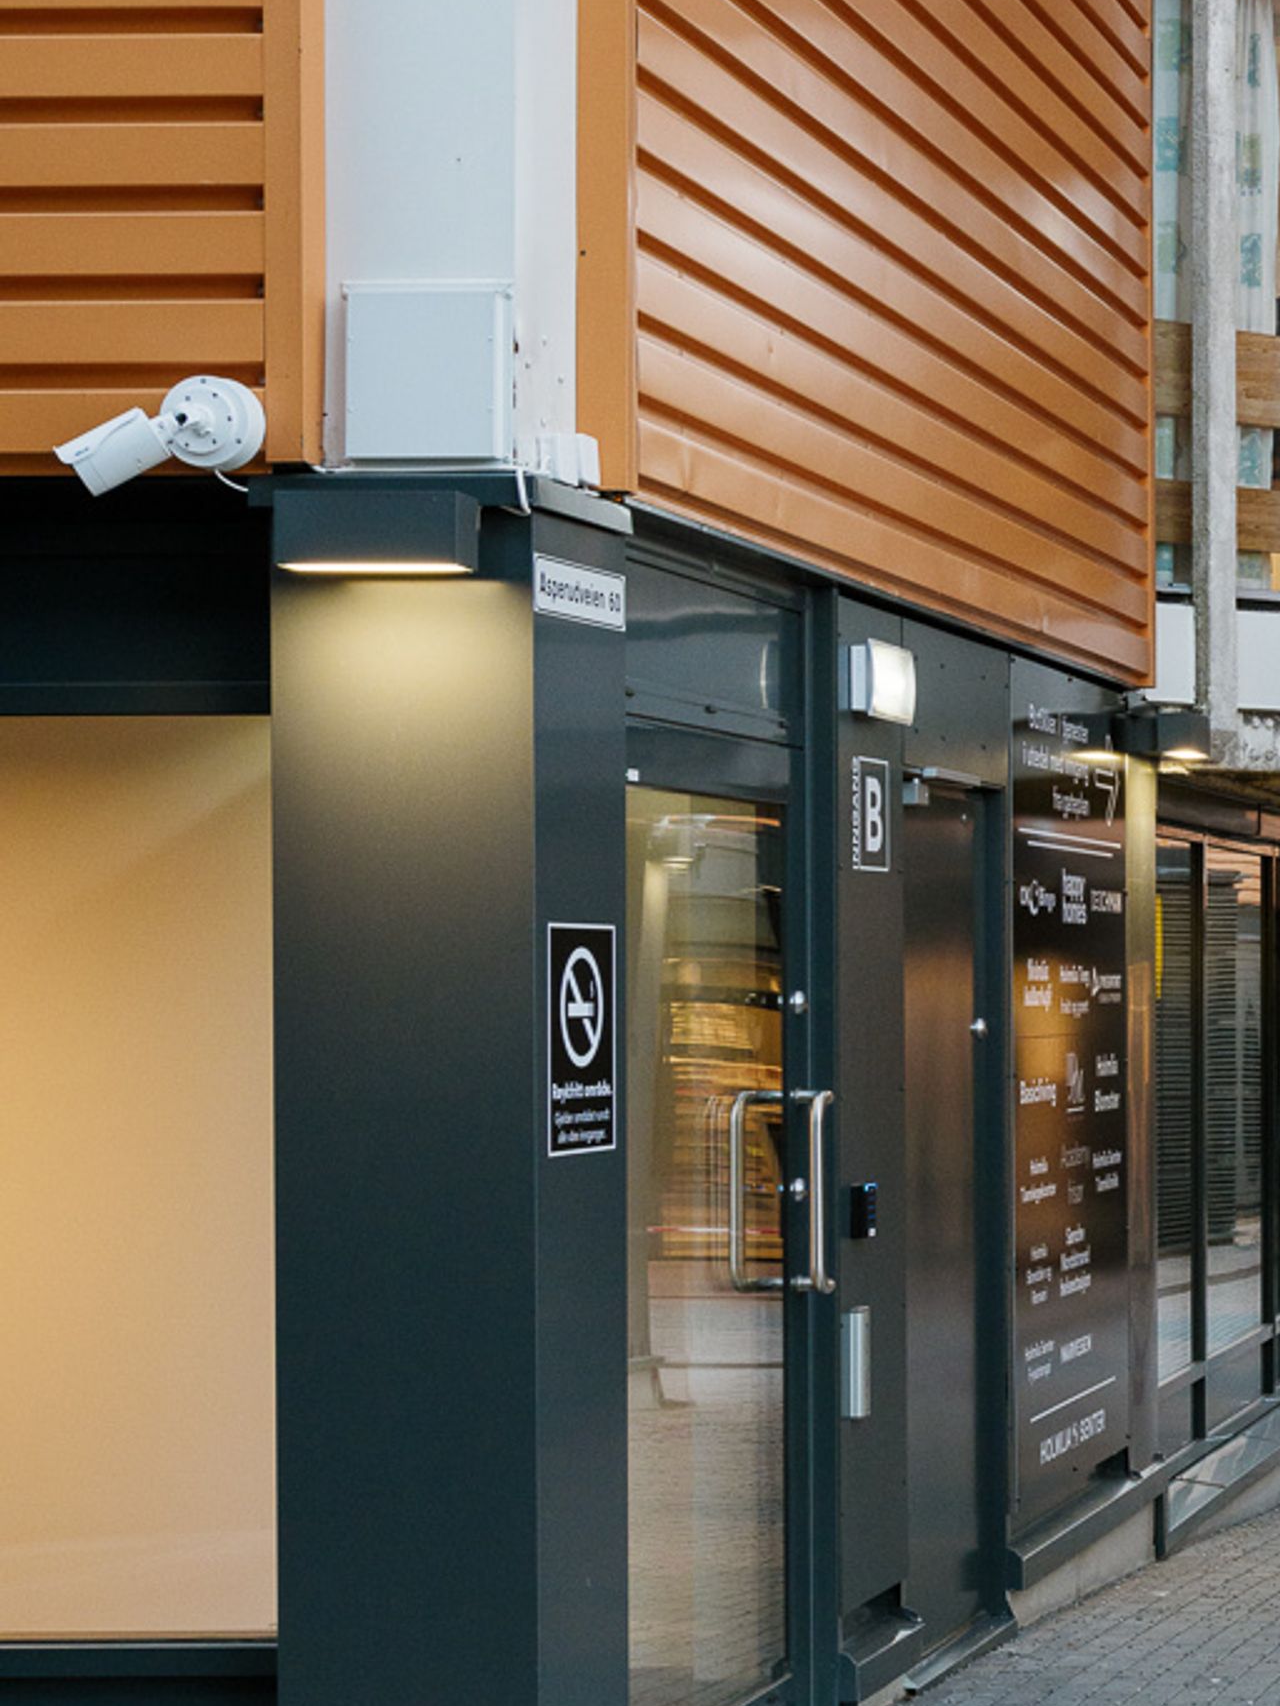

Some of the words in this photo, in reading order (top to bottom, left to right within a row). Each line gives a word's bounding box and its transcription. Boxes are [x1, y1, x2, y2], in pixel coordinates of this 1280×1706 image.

[540, 571, 606, 609] Asperudveien
[609, 591, 621, 613] 60
[852, 756, 862, 870] INNGANG
[865, 775, 883, 852] B
[1061, 867, 1086, 902] happy
[1062, 898, 1088, 924] homes
[1060, 1334, 1092, 1363] NARVESEN
[1040, 1424, 1072, 1465] HOLMLIA
[1080, 1408, 1106, 1442] SENTER
